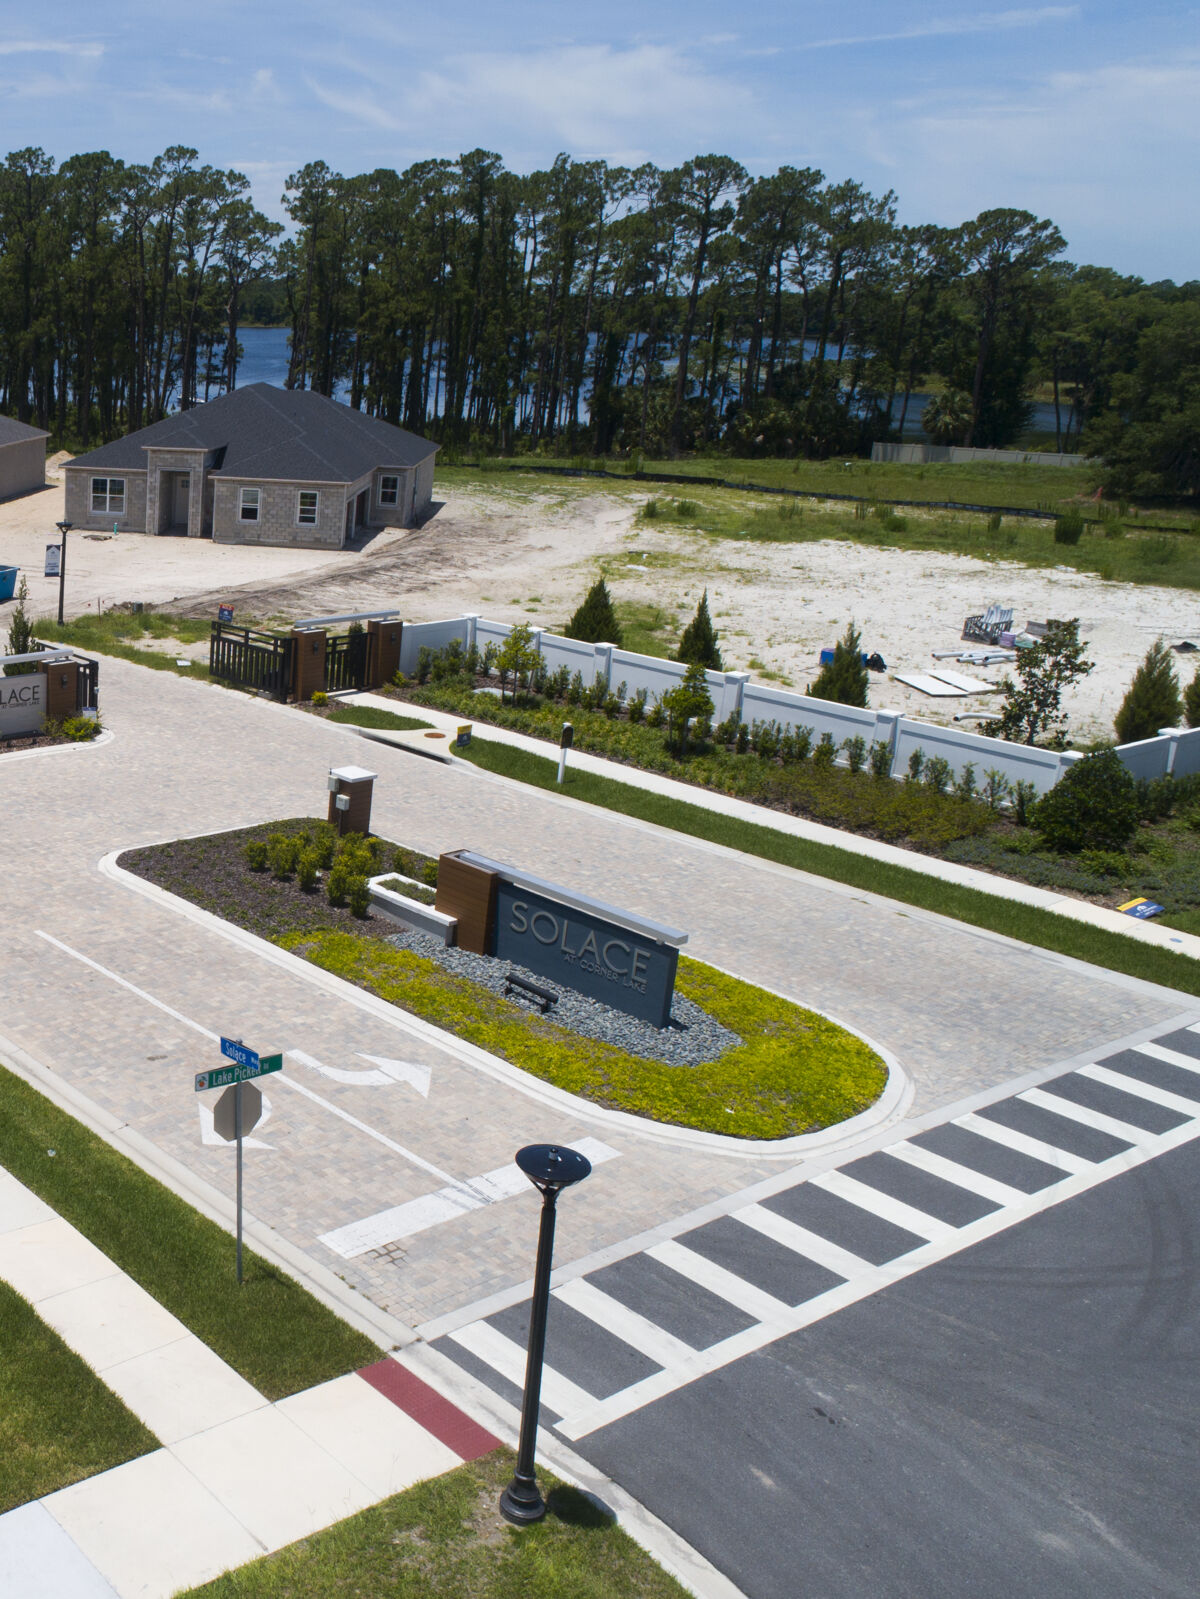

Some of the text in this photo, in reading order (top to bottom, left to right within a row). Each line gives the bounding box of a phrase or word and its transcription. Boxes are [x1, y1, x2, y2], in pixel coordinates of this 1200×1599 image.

[510, 901, 651, 985] SOLACE
[564, 953, 647, 993] AT CORNER LAKE
[225, 1042, 246, 1063] Solace
[212, 1070, 233, 1086] Lake
